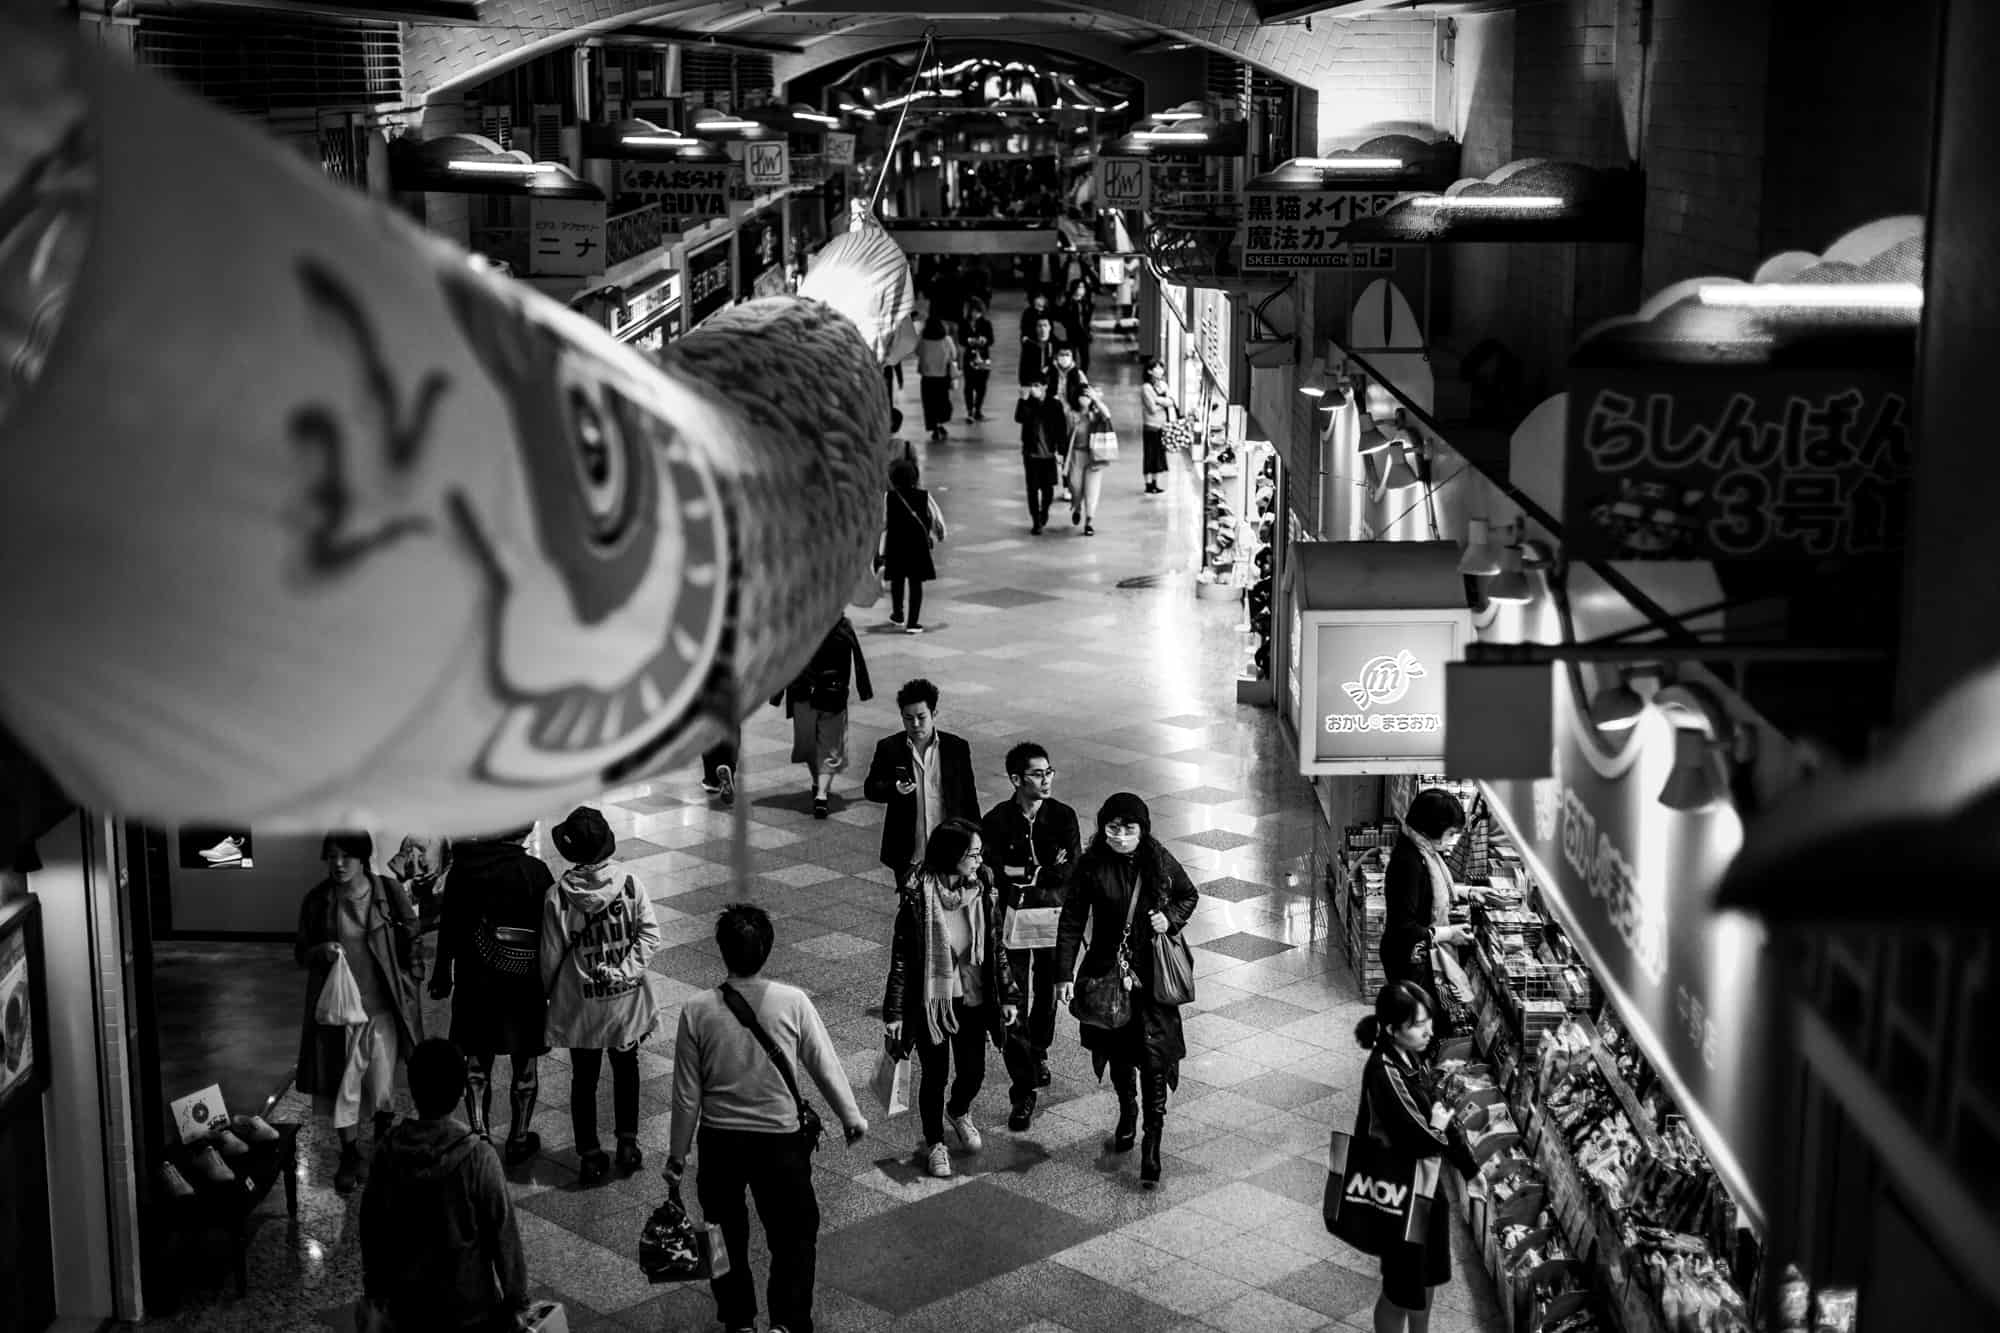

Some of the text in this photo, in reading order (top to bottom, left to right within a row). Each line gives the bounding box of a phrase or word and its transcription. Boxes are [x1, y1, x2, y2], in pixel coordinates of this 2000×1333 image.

[638, 170, 725, 188] まんだらけ
[1247, 195, 1369, 220] 黒猫メイド
[1247, 226, 1347, 249] 魔法カフ
[1247, 254, 1310, 266] SKELETON
